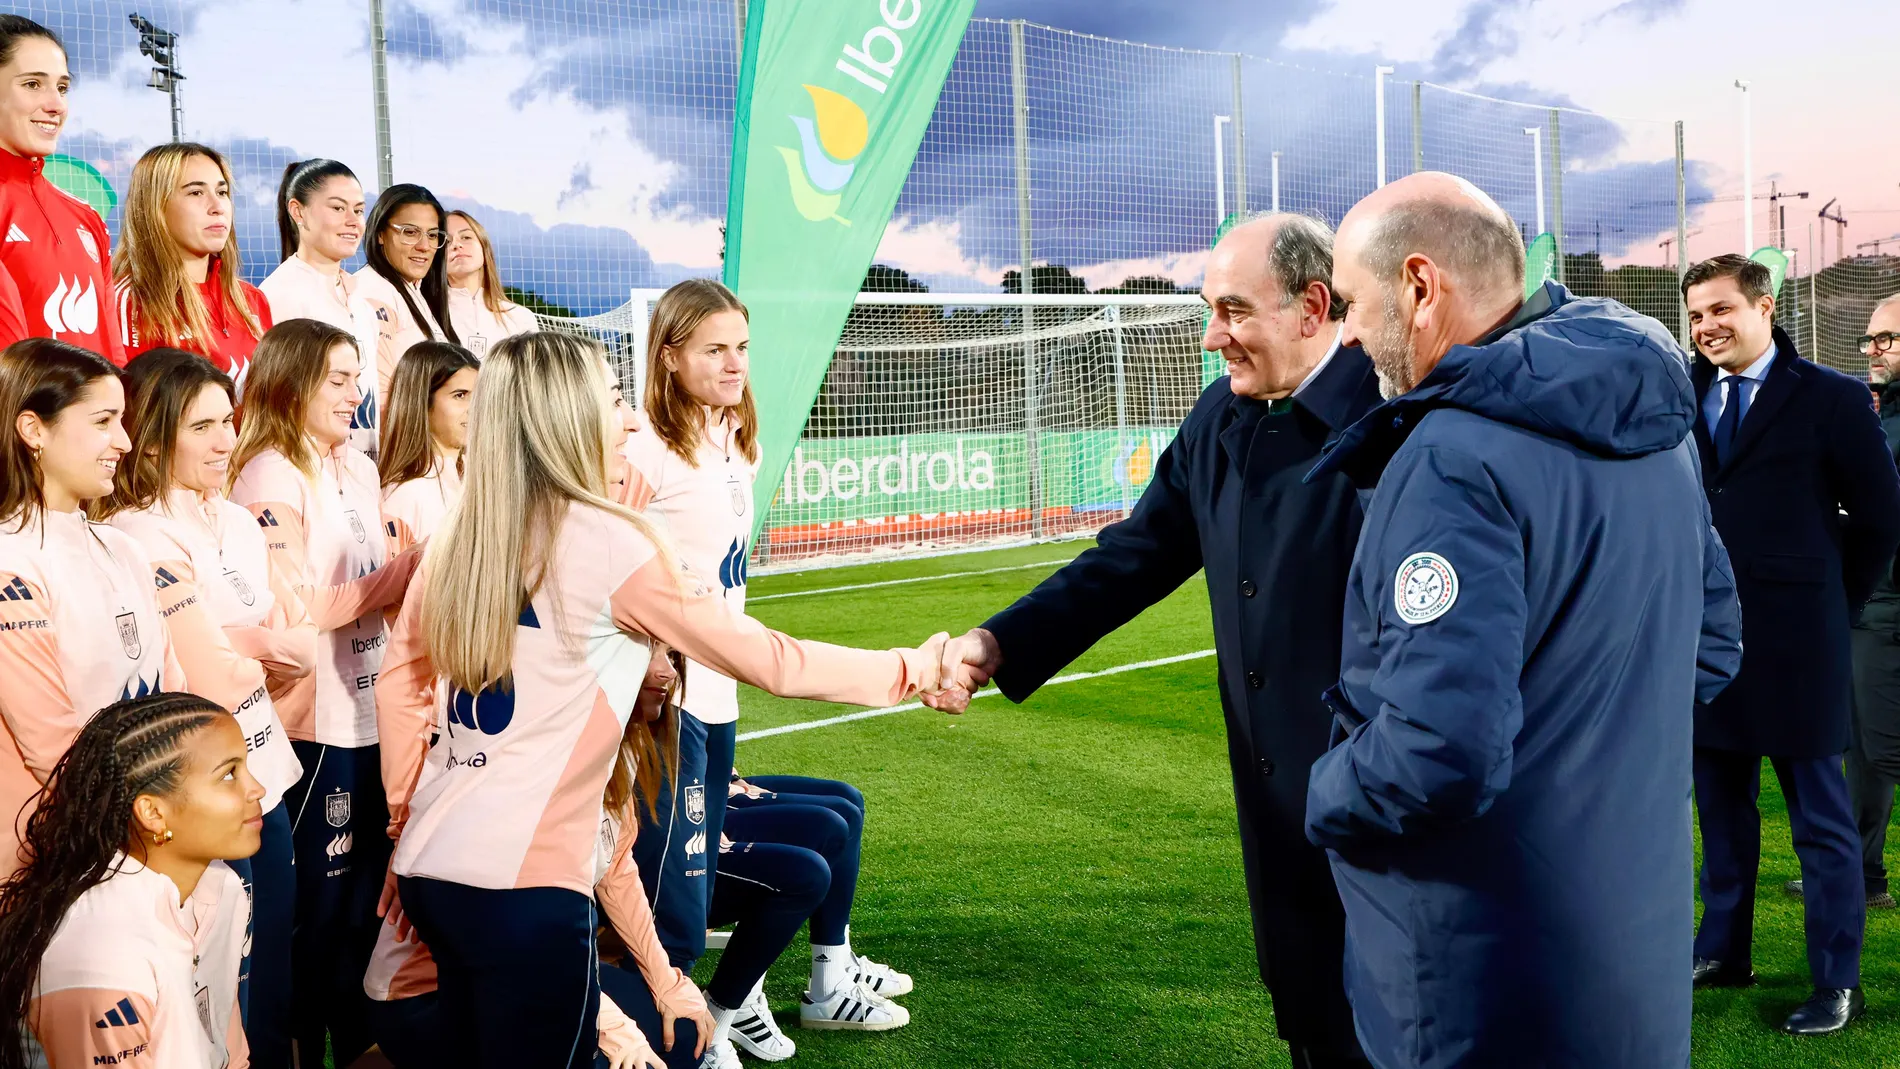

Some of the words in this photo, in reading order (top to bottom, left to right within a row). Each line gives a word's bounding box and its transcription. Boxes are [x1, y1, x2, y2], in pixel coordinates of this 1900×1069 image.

[784, 438, 994, 504] Iberdrola
[0, 619, 50, 631] MAPFRE
[93, 1042, 149, 1066] MAPFRE
